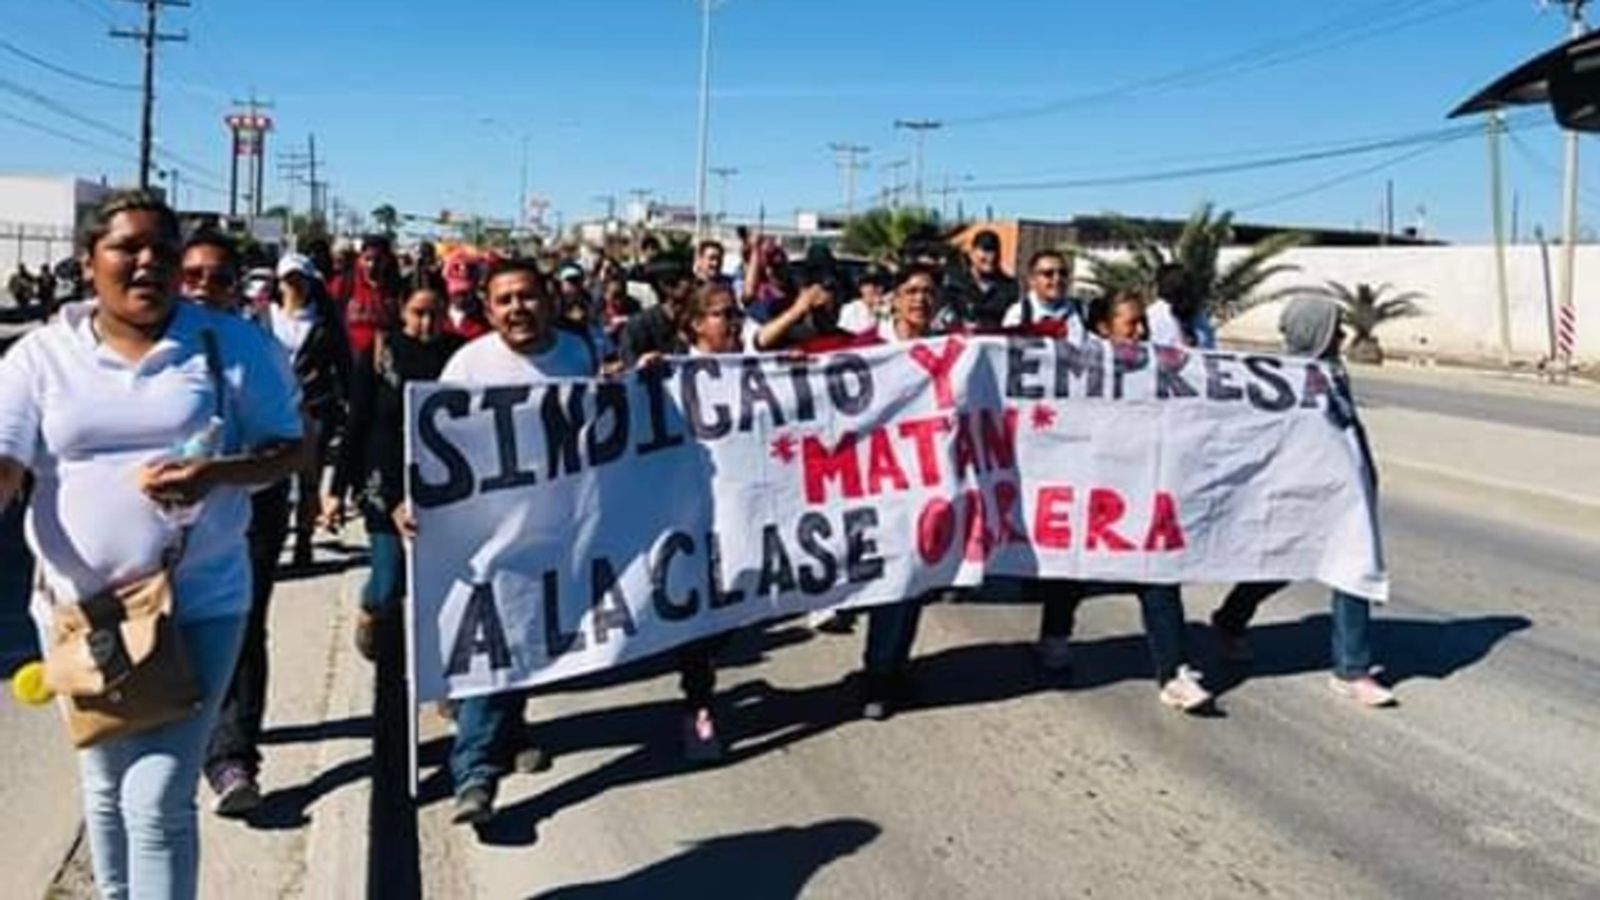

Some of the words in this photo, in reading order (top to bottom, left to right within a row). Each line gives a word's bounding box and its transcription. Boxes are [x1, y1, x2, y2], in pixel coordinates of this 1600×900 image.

[408, 352, 875, 508] SINDICATO
[909, 337, 966, 407] Y
[1005, 336, 1340, 413] EMPRESA
[444, 580, 512, 677] A
[543, 557, 639, 656] LA
[651, 506, 885, 622] CLASE
